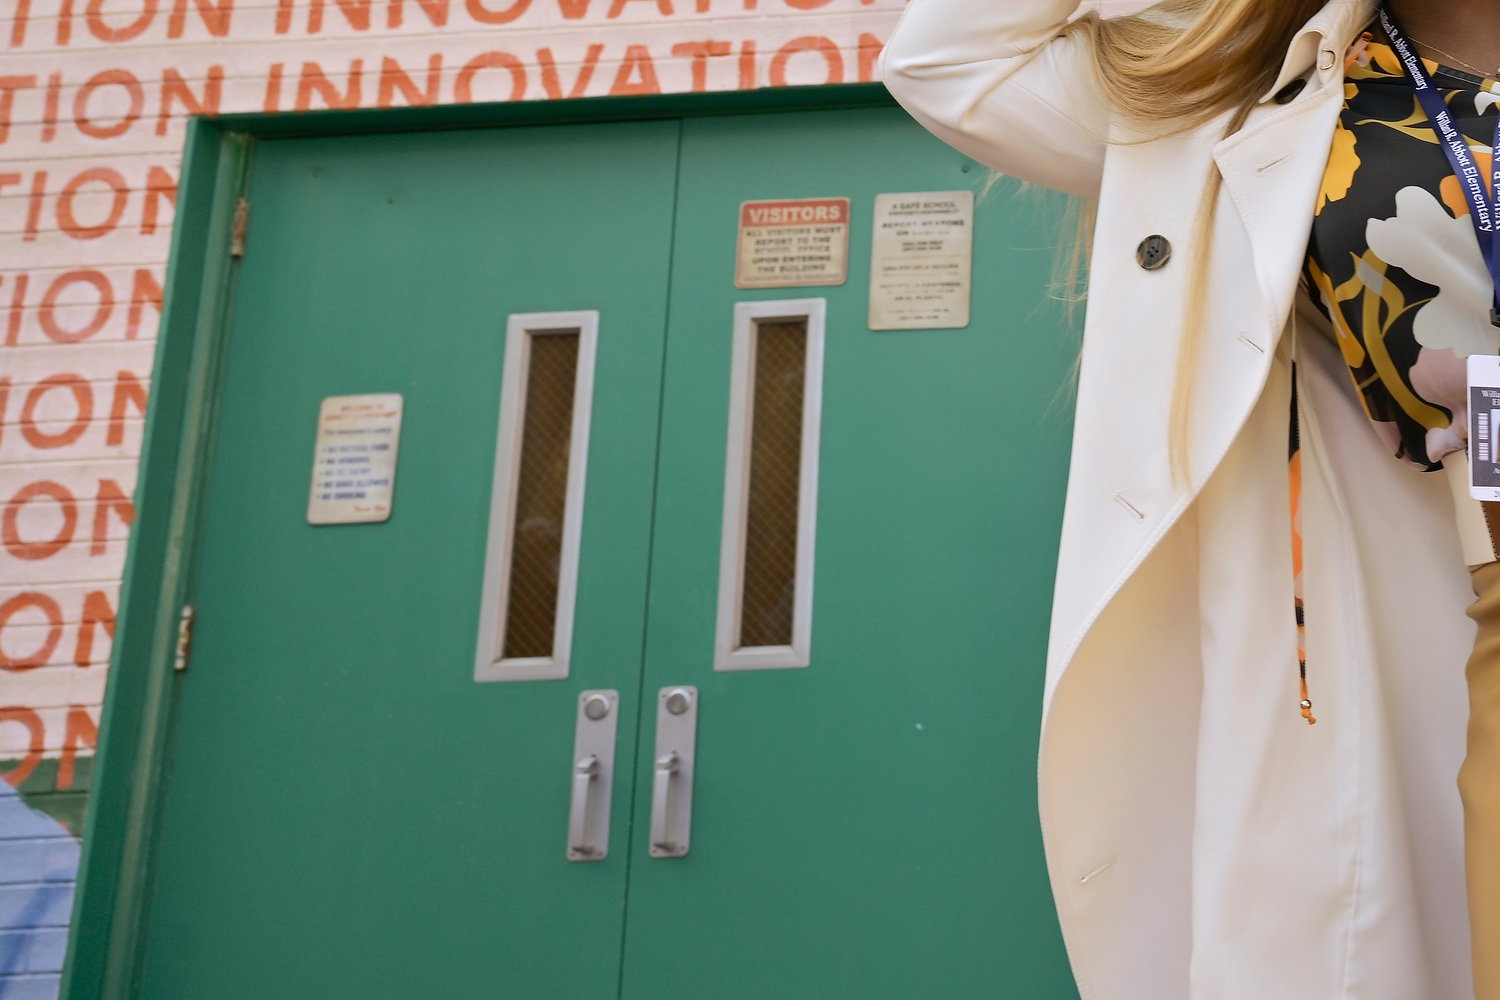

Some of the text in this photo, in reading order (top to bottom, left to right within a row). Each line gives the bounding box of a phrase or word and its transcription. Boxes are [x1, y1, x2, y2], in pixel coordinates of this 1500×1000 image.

[1404, 55, 1429, 91] Elementary
[1435, 110, 1455, 135] Willard
[1448, 140, 1471, 167] Abbott
[1462, 166, 1494, 232] Elementary
[749, 204, 842, 224] VISITORS
